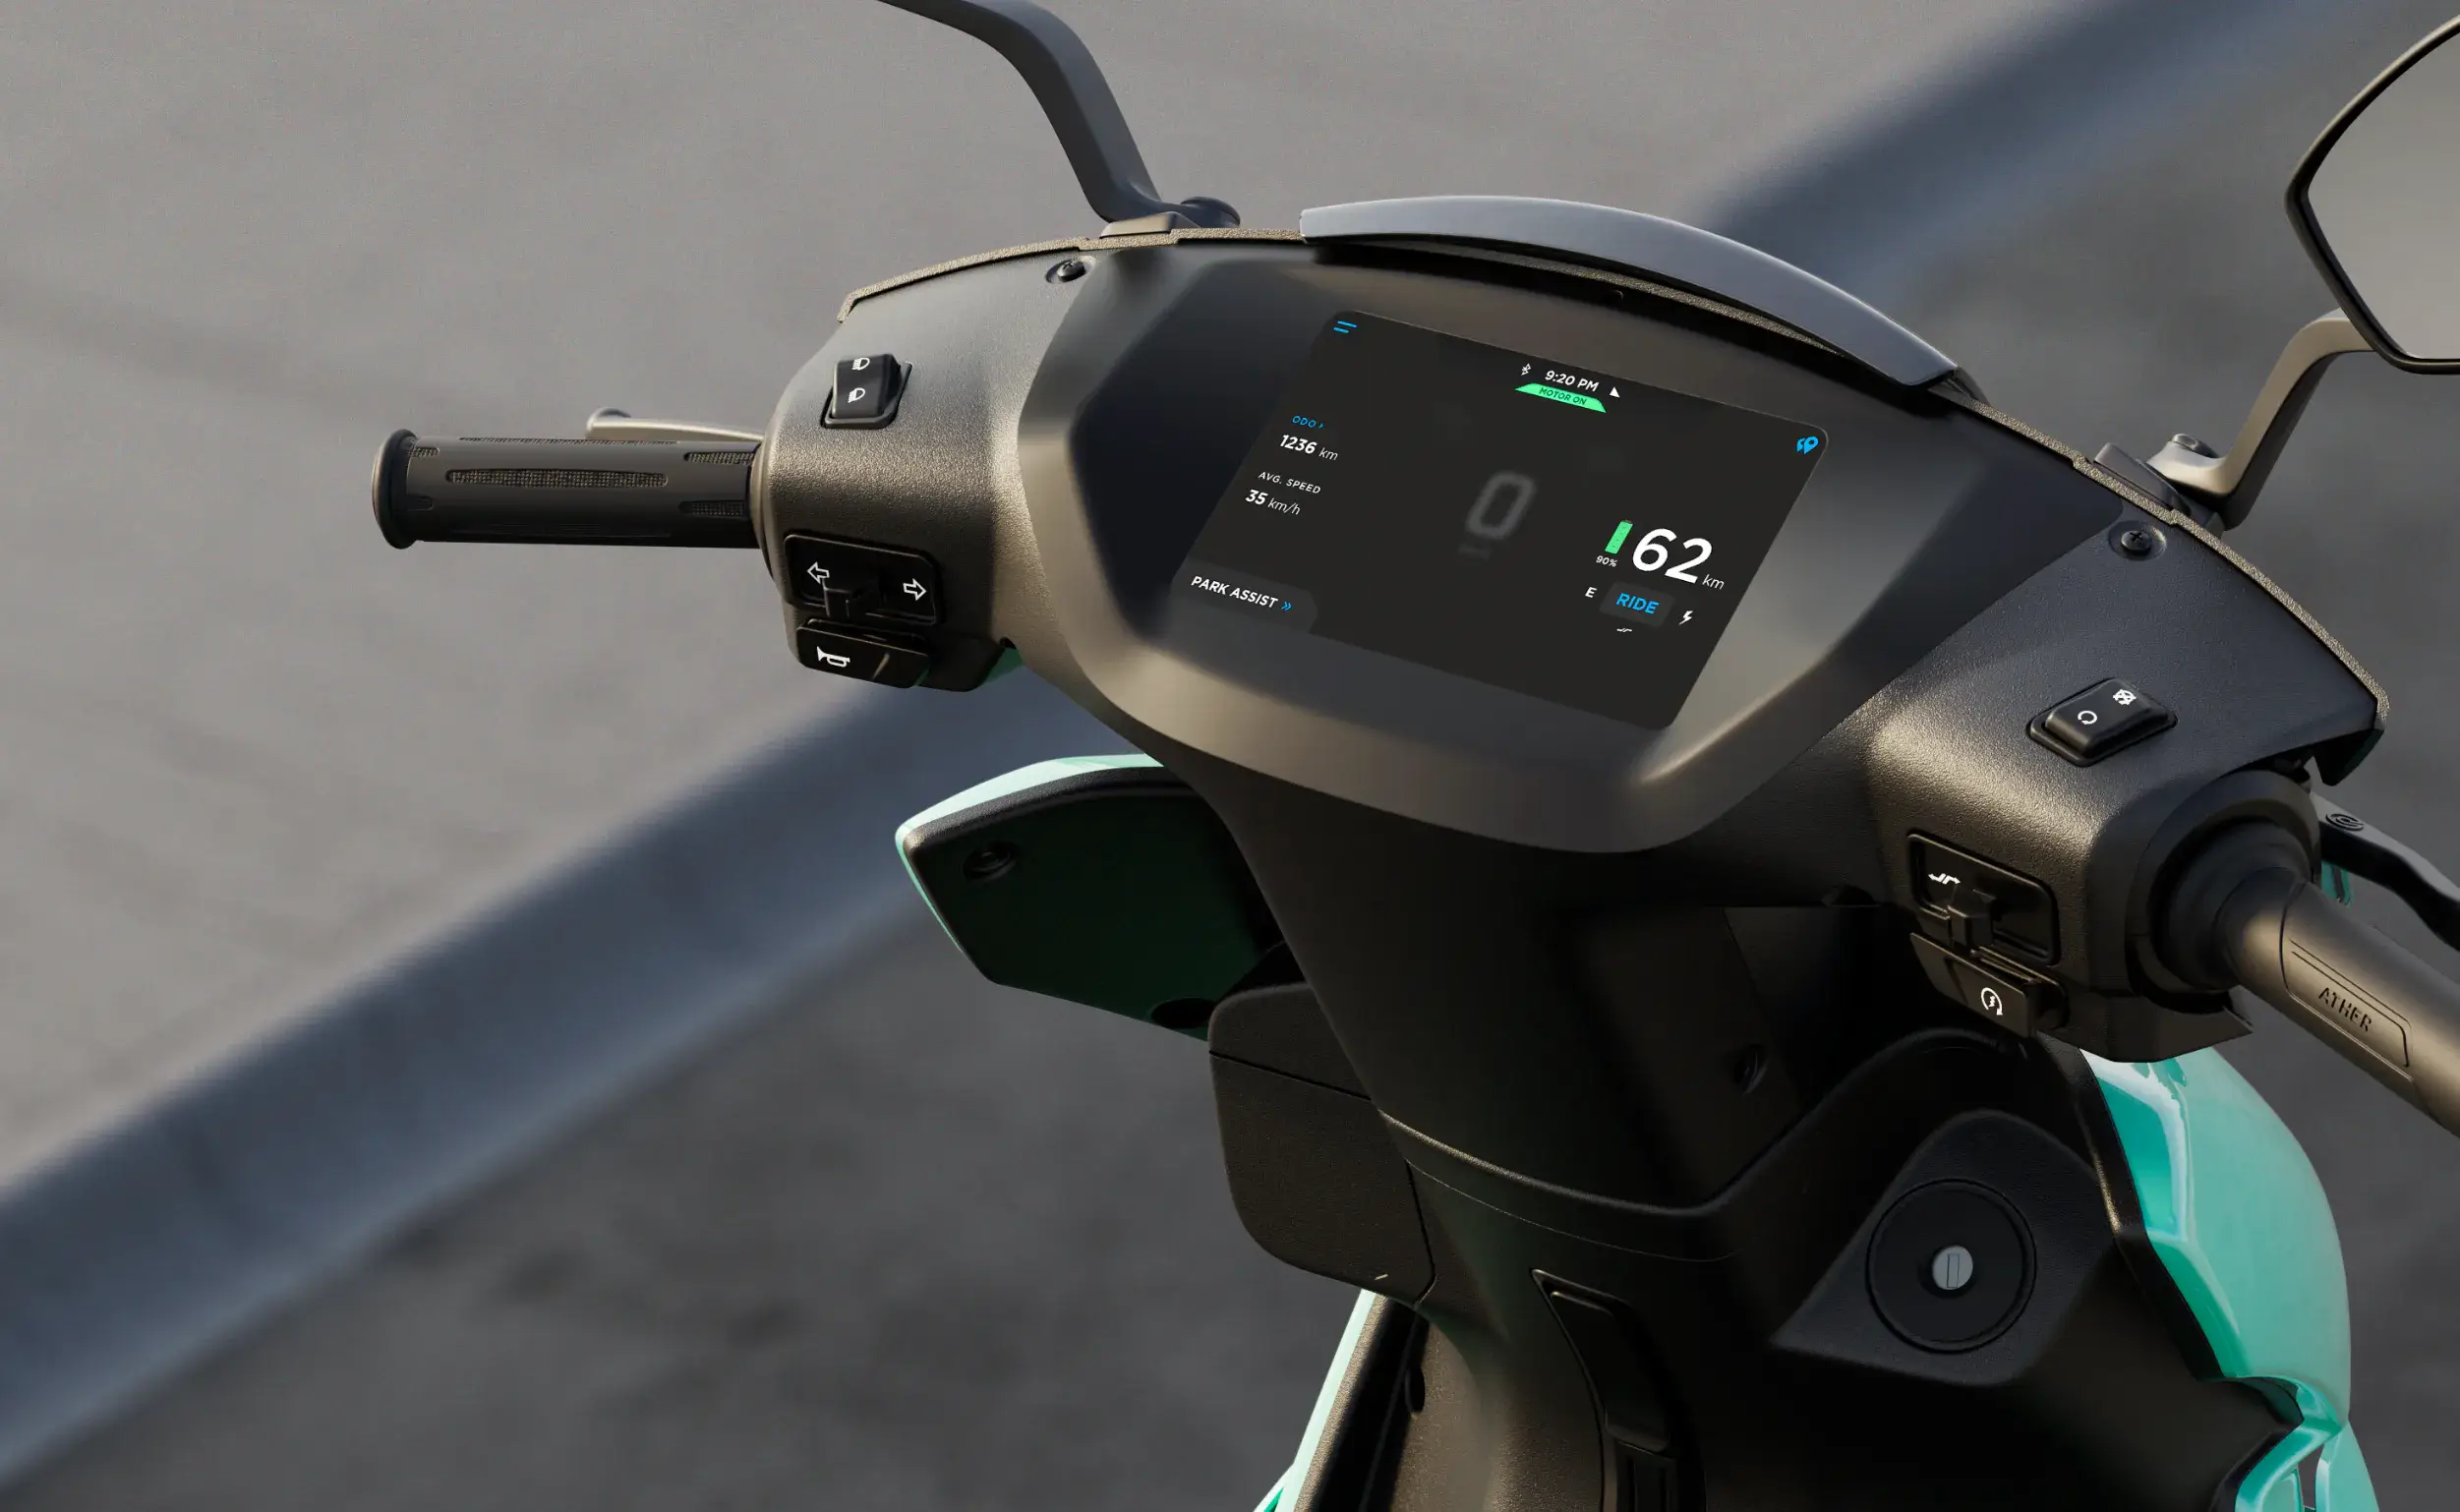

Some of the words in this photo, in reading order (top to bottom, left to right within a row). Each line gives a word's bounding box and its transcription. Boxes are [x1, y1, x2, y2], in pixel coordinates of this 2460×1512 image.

[1545, 370, 1576, 386] 9:20
[1577, 378, 1600, 392] PM
[1539, 387, 1571, 401] MOTOR
[1572, 396, 1587, 405] ON
[1292, 415, 1317, 429] ODO
[1279, 434, 1318, 454] 1236
[1318, 447, 1338, 461] km
[1258, 471, 1283, 485] AVG.
[1285, 478, 1321, 494] SPEED
[1245, 489, 1268, 505] 35
[1267, 496, 1301, 515] km/h
[1465, 471, 1536, 539] 0
[1596, 555, 1618, 567] 90%
[1632, 528, 1713, 584] 62
[1702, 574, 1725, 590] km
[1191, 575, 1230, 595] PARK
[1229, 587, 1278, 609] ASSIST
[1585, 586, 1598, 598] E
[1615, 592, 1660, 614] RIDE
[2318, 987, 2372, 1032] ATHER
